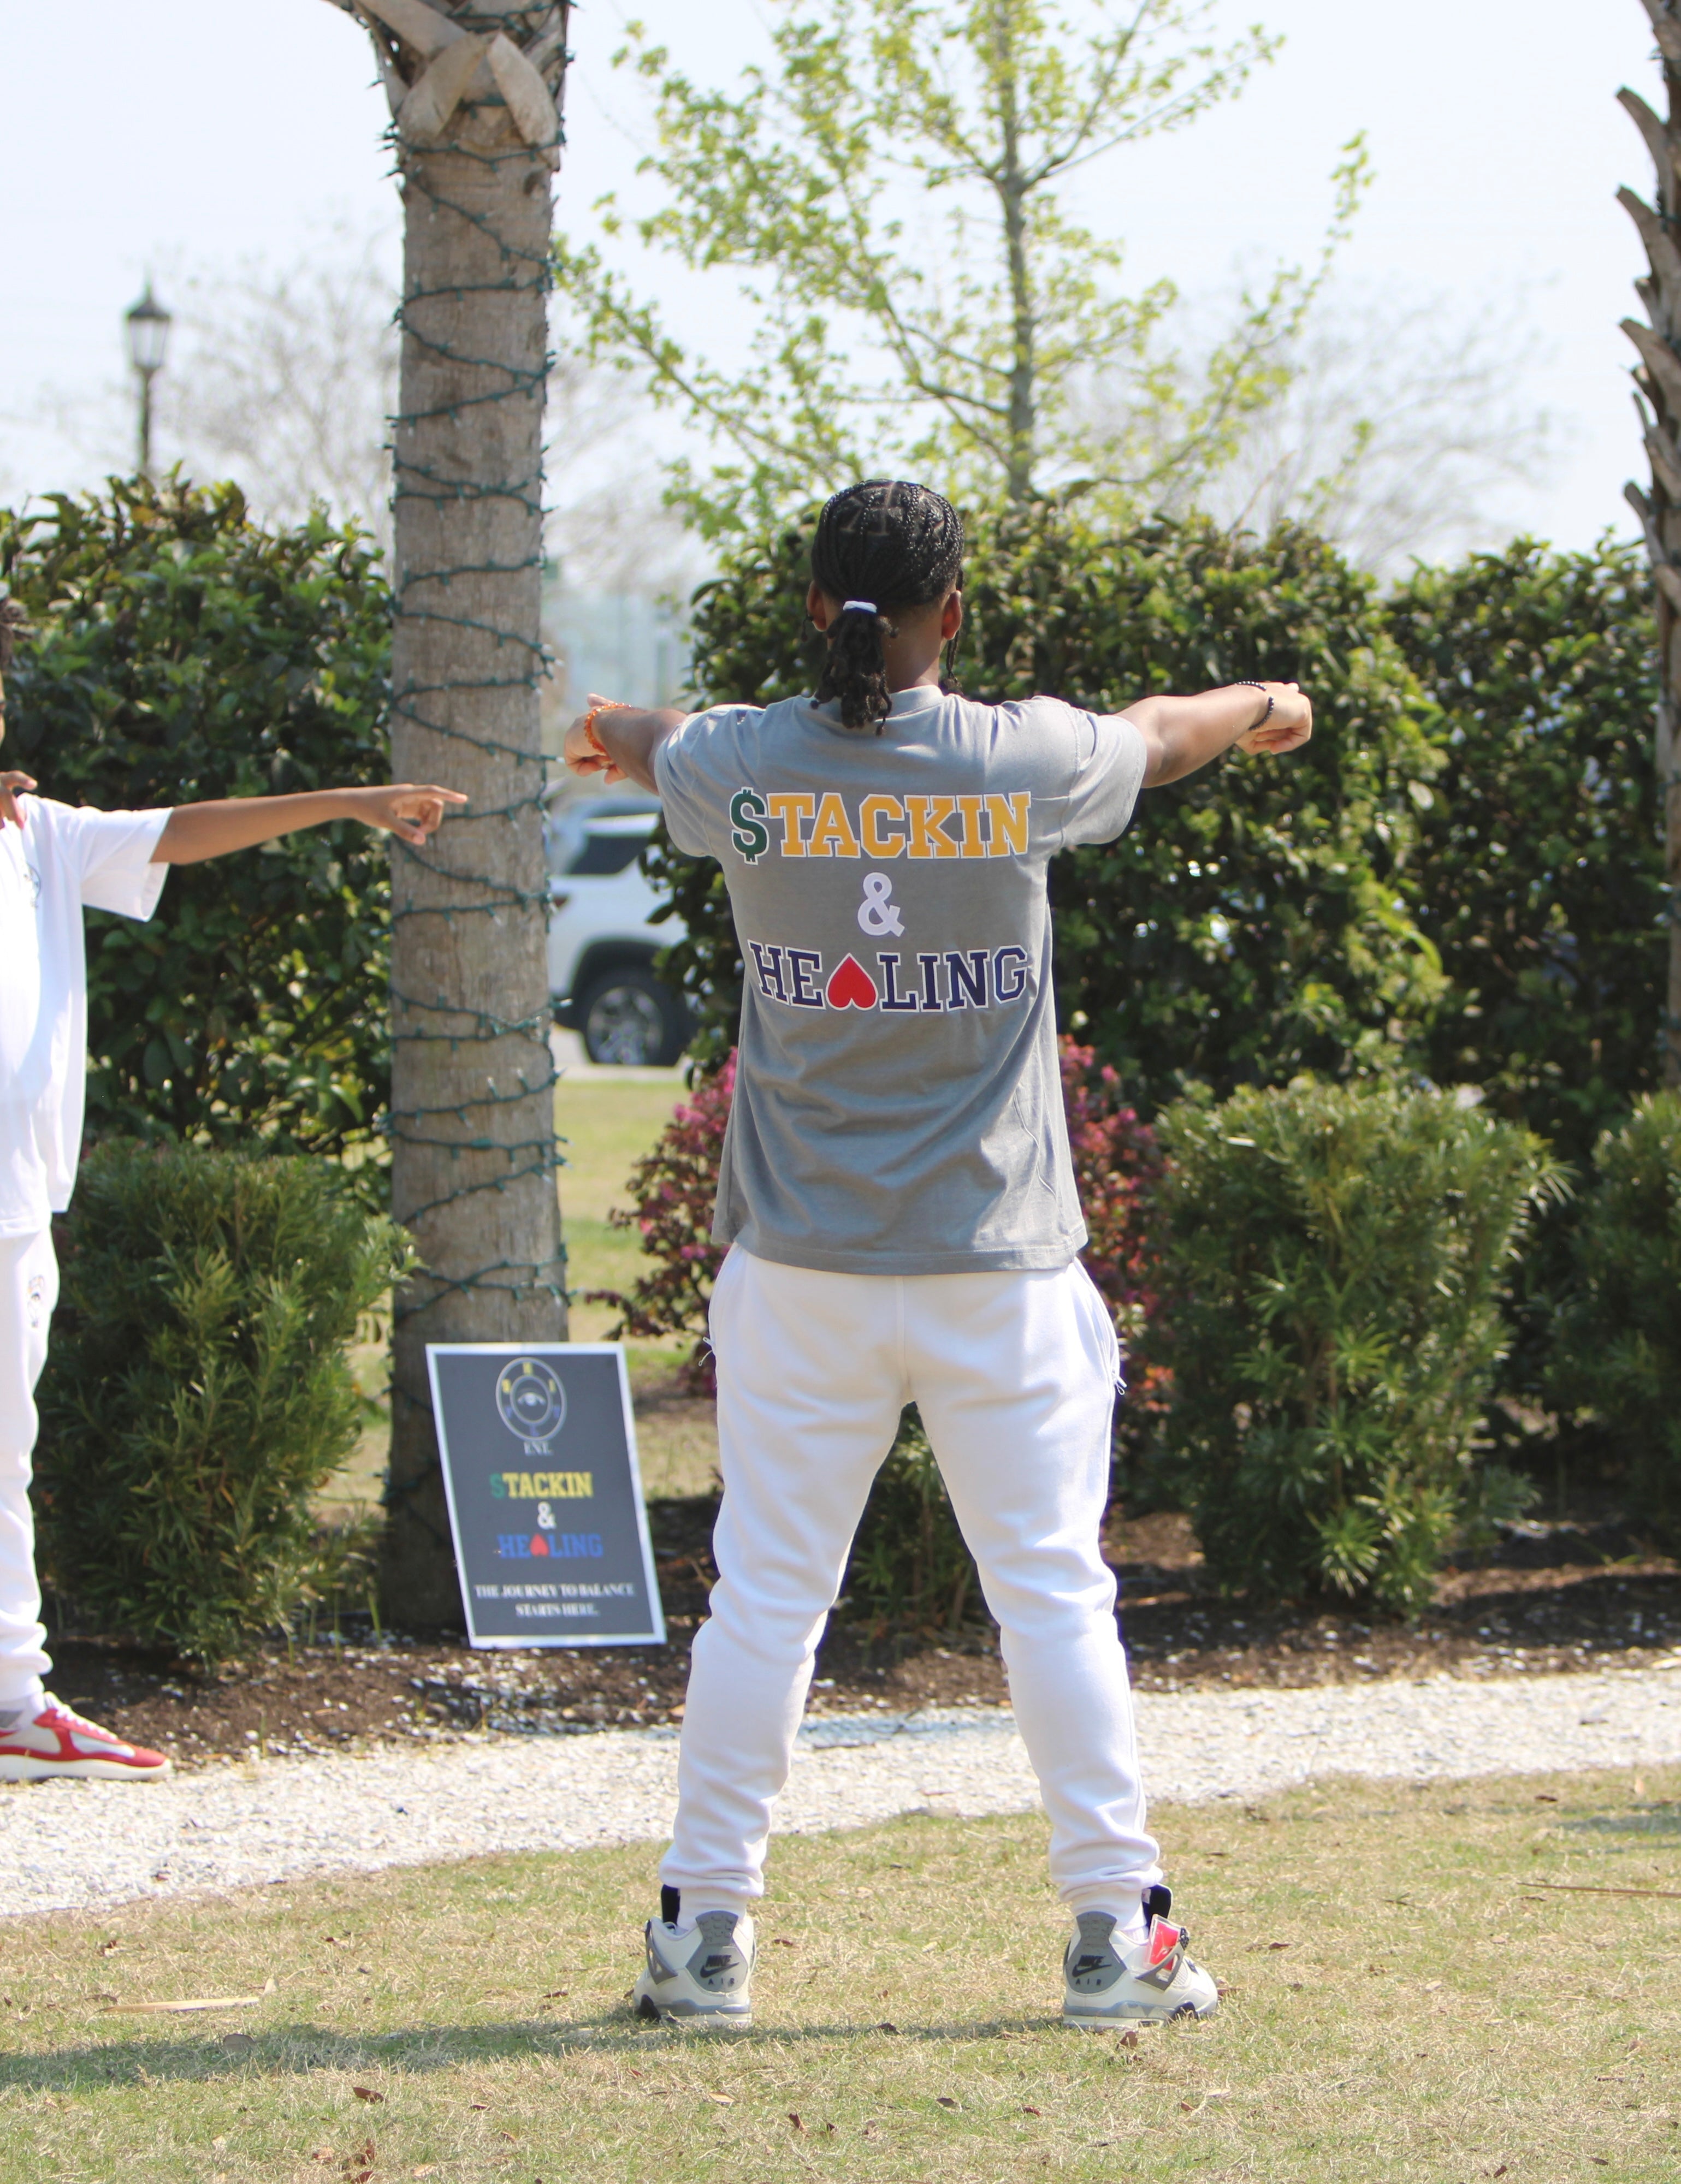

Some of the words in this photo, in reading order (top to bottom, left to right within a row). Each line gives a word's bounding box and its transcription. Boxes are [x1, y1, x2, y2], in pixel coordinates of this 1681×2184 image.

[857, 872, 905, 937] &
[747, 939, 1028, 1012] HELING
[537, 1501, 557, 1529] &
[497, 1535, 603, 1558] HELING
[474, 1584, 499, 1599] THE
[501, 1584, 558, 1598] JOURNEY
[559, 1583, 578, 1598] TO
[578, 1583, 634, 1598] BALANCE
[515, 1603, 561, 1617] STARTS
[705, 1955, 731, 1967] NIKE
[1078, 1955, 1105, 1967] NIKE
